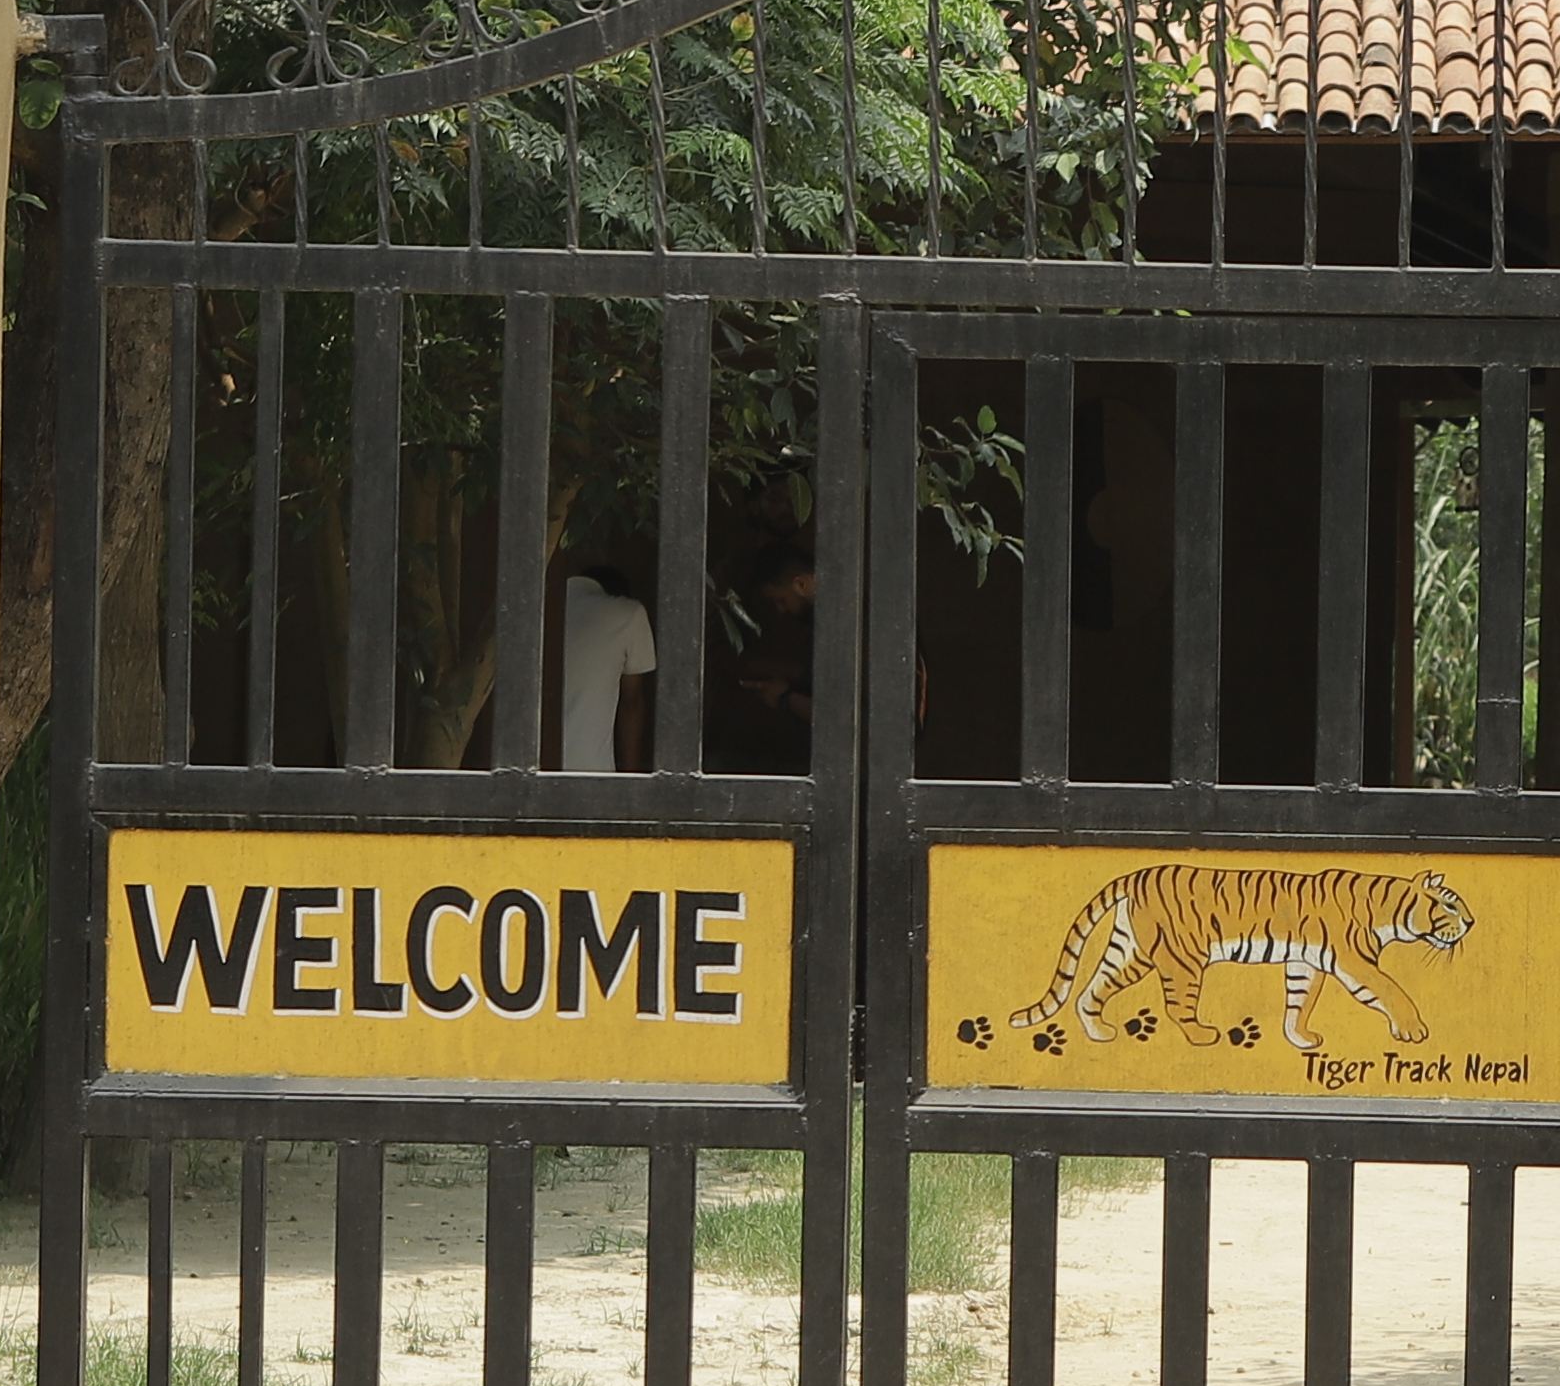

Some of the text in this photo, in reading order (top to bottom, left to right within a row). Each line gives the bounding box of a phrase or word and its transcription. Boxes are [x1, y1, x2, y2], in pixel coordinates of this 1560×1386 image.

[124, 883, 745, 1024] WELCOME
[1301, 1052, 1529, 1090] Tiger Track Nepal
